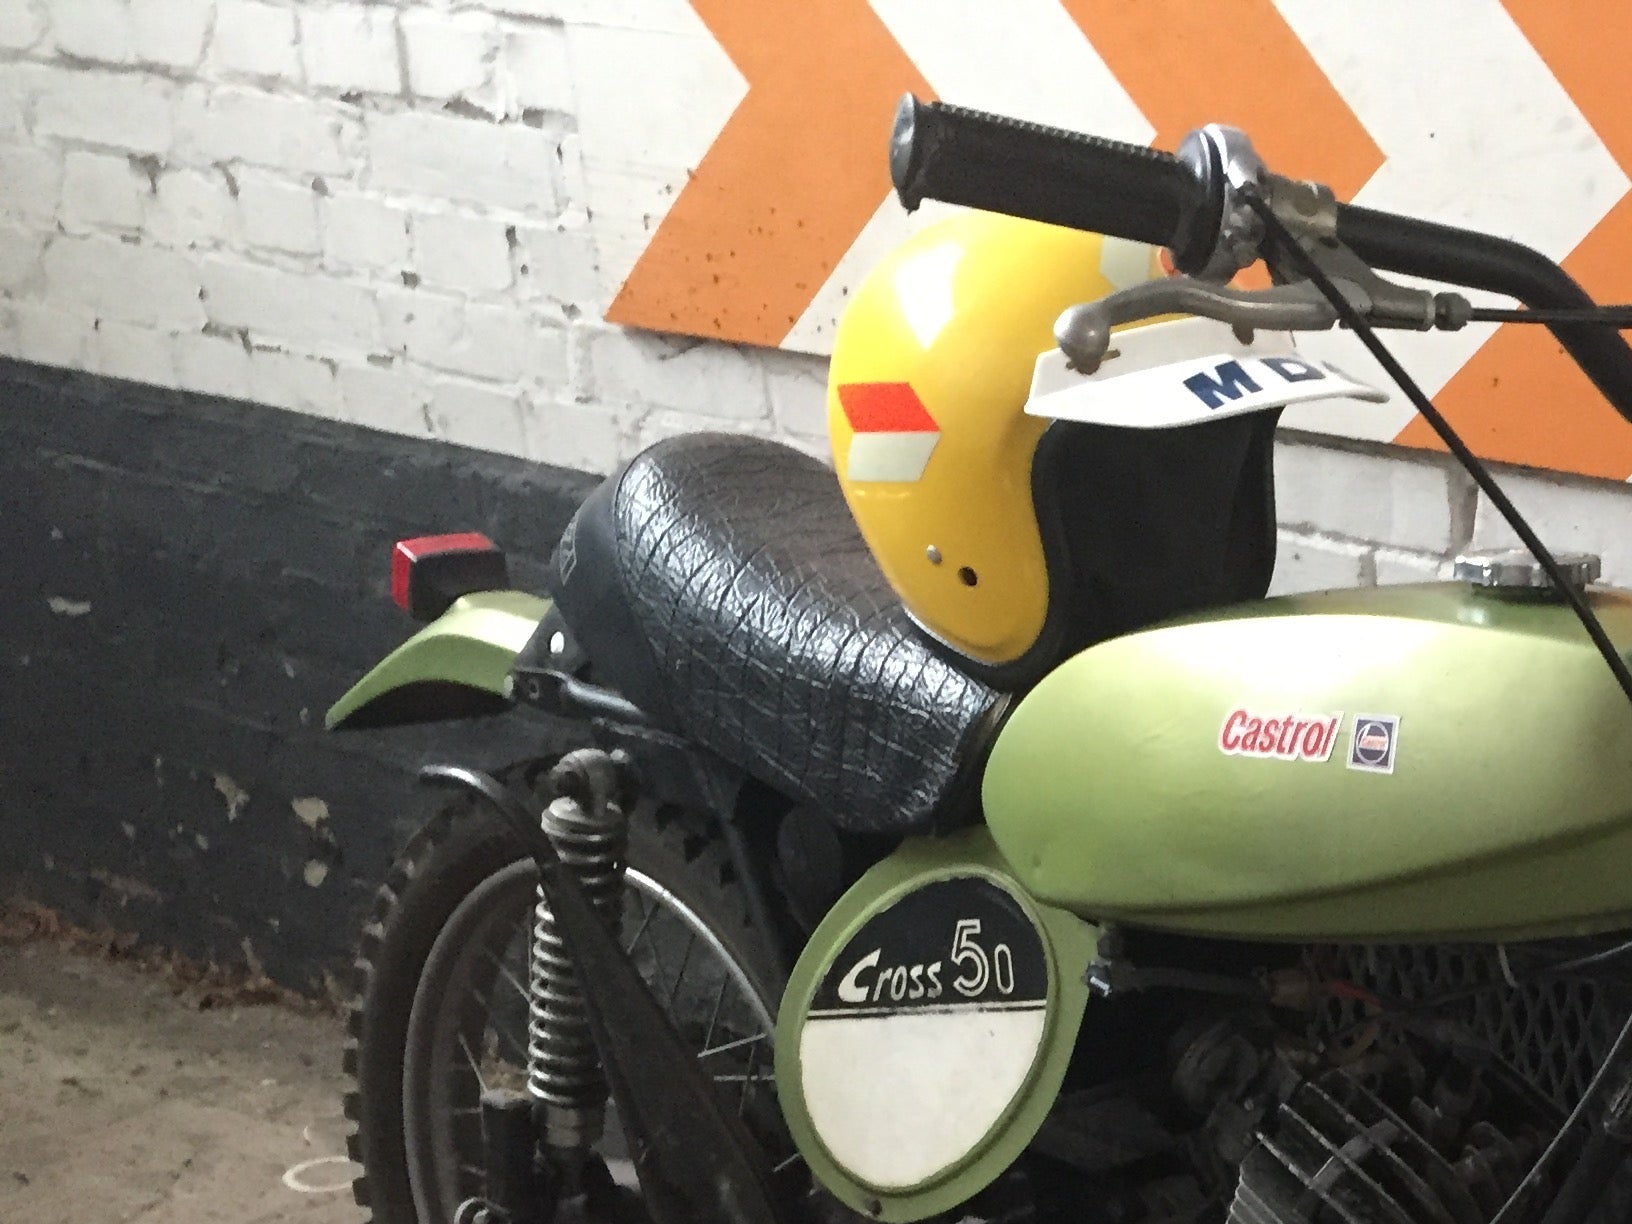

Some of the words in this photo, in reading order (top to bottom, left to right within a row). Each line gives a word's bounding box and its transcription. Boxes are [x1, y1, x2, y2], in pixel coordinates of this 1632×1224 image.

[1183, 358, 1342, 410] MD
[1221, 710, 1338, 756] Castrol
[838, 947, 942, 1003] Cross
[951, 918, 1015, 998] 50
